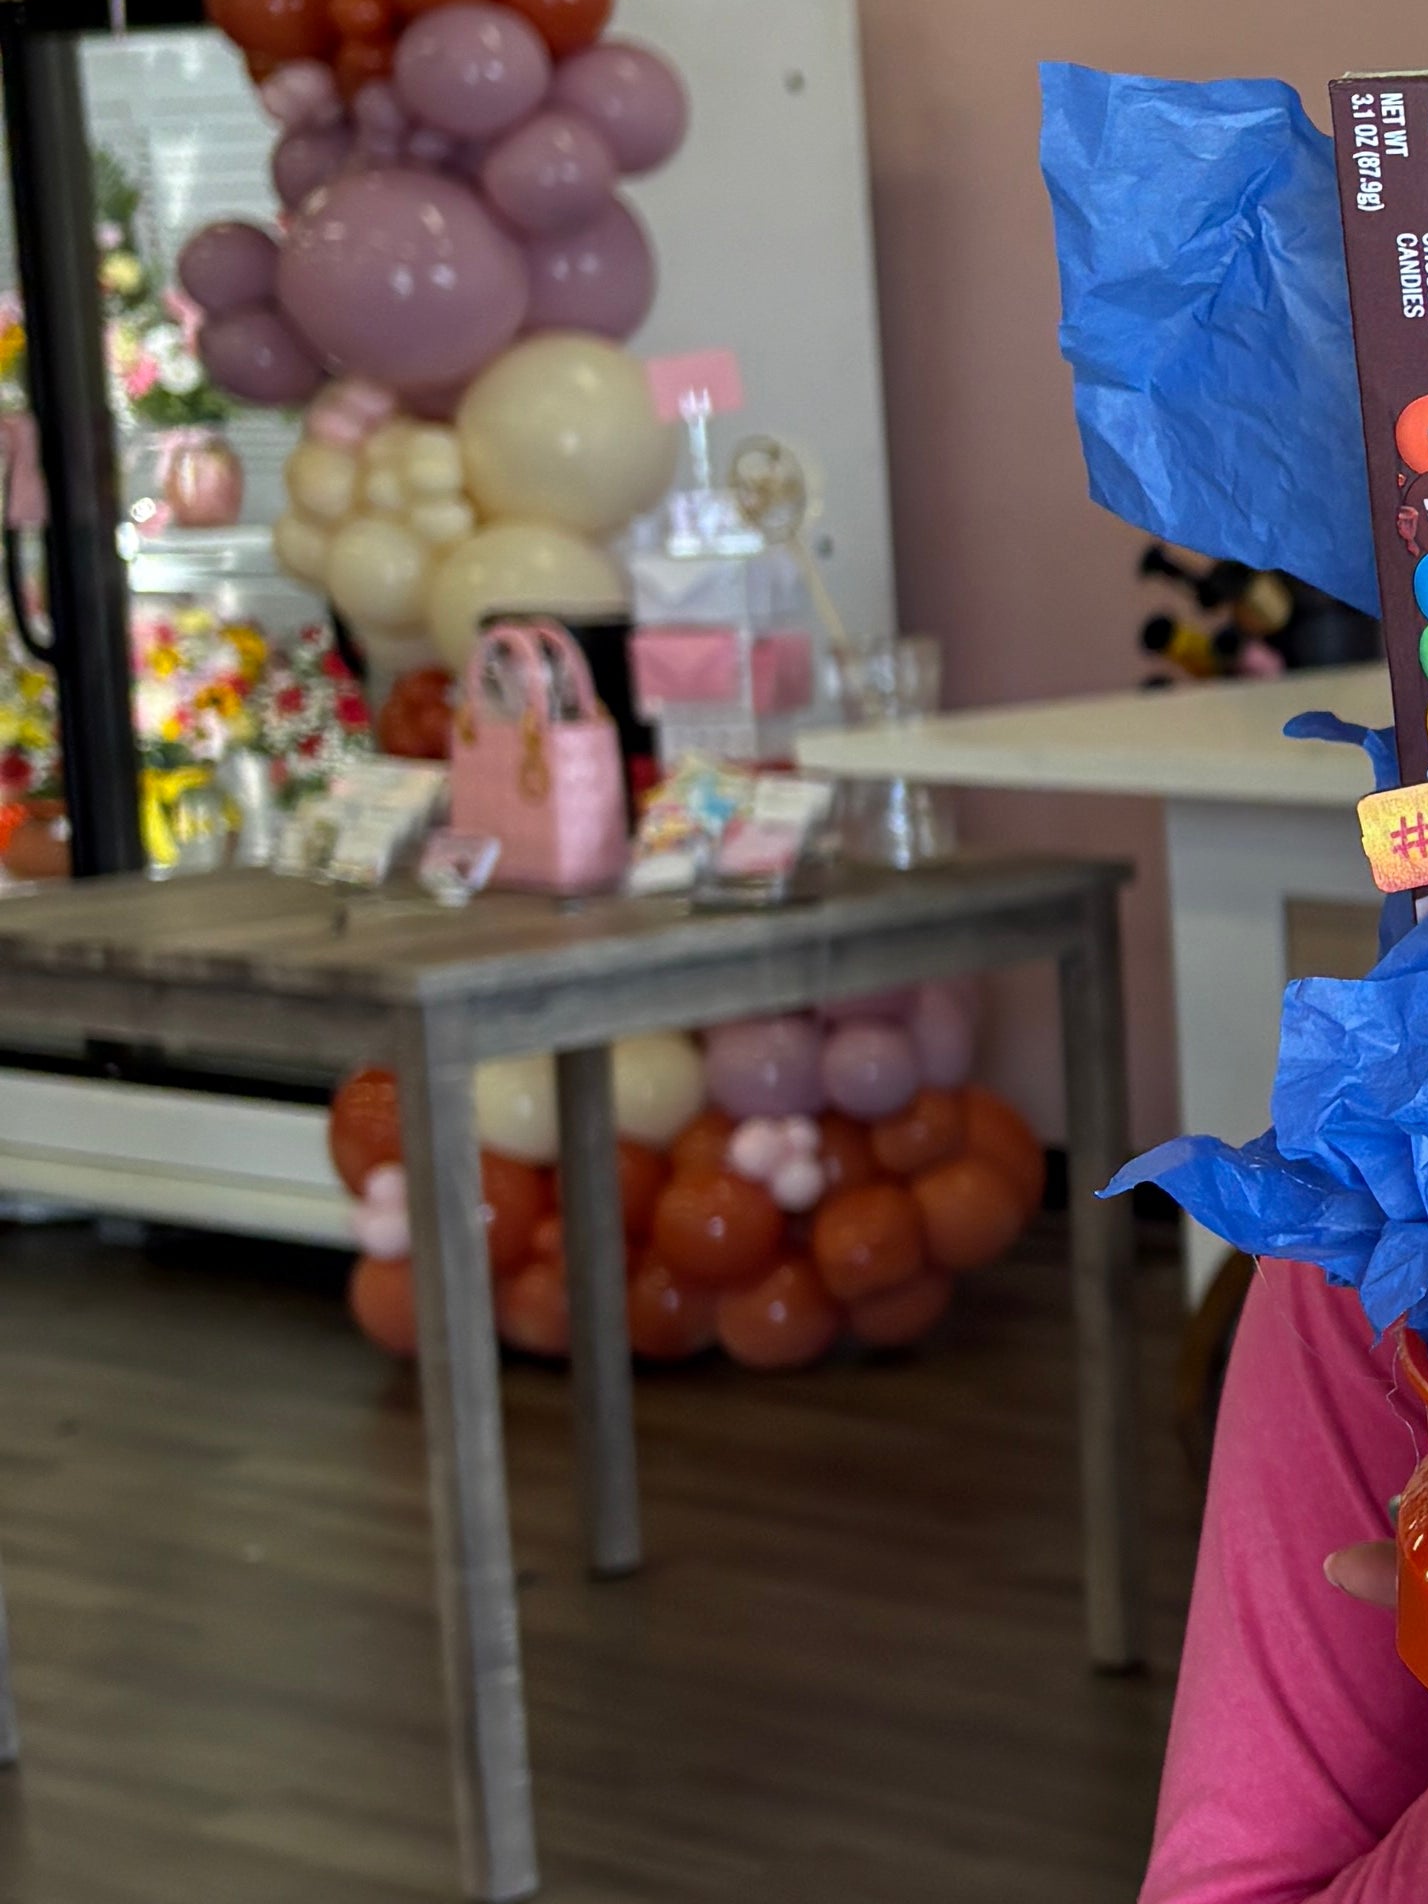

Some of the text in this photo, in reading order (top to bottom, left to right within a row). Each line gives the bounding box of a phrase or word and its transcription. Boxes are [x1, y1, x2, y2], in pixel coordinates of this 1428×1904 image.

[1351, 94, 1385, 211] 3.1 OZ (87.9g)
[1380, 93, 1408, 157] NET WT
[1396, 233, 1425, 319] CANDIES
